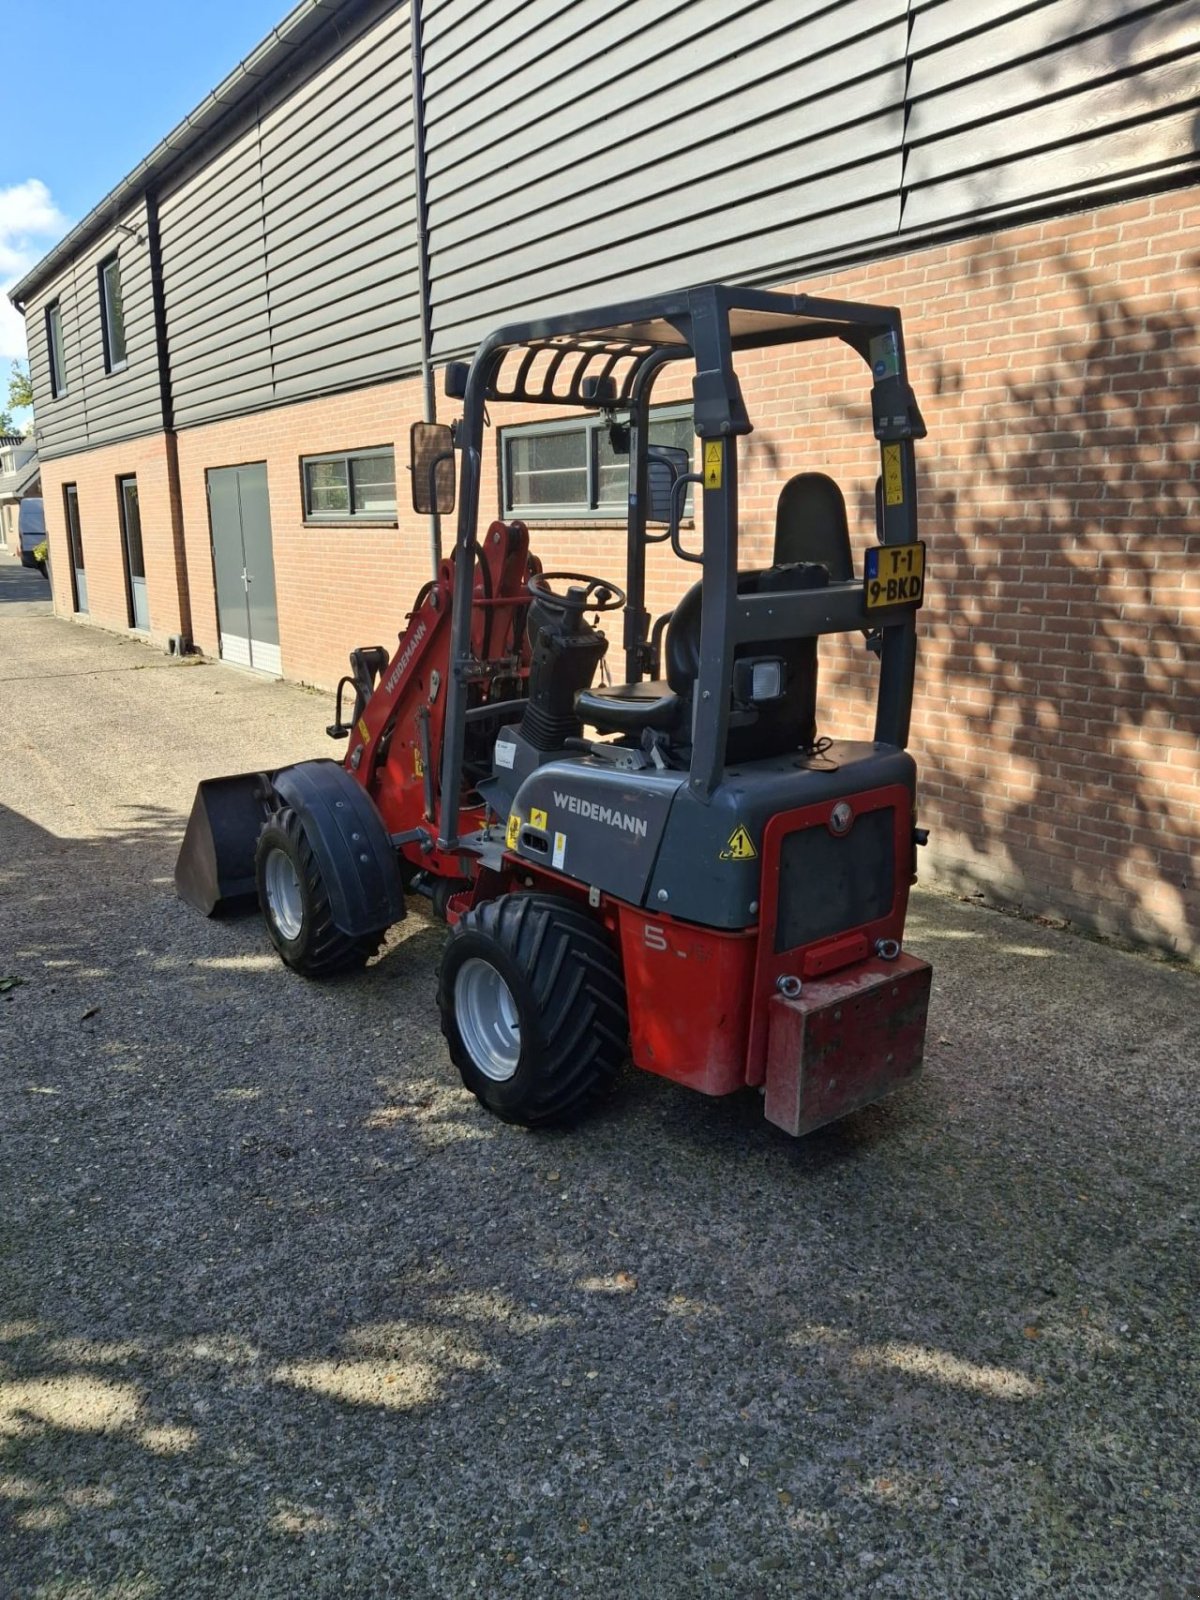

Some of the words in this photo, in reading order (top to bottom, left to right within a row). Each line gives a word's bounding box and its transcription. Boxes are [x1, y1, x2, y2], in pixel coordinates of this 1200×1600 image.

[890, 549, 913, 573] T-1
[870, 575, 920, 604] 9-BKD
[385, 621, 427, 695] WEIDEMANN
[553, 791, 647, 837] WEIDEMANN
